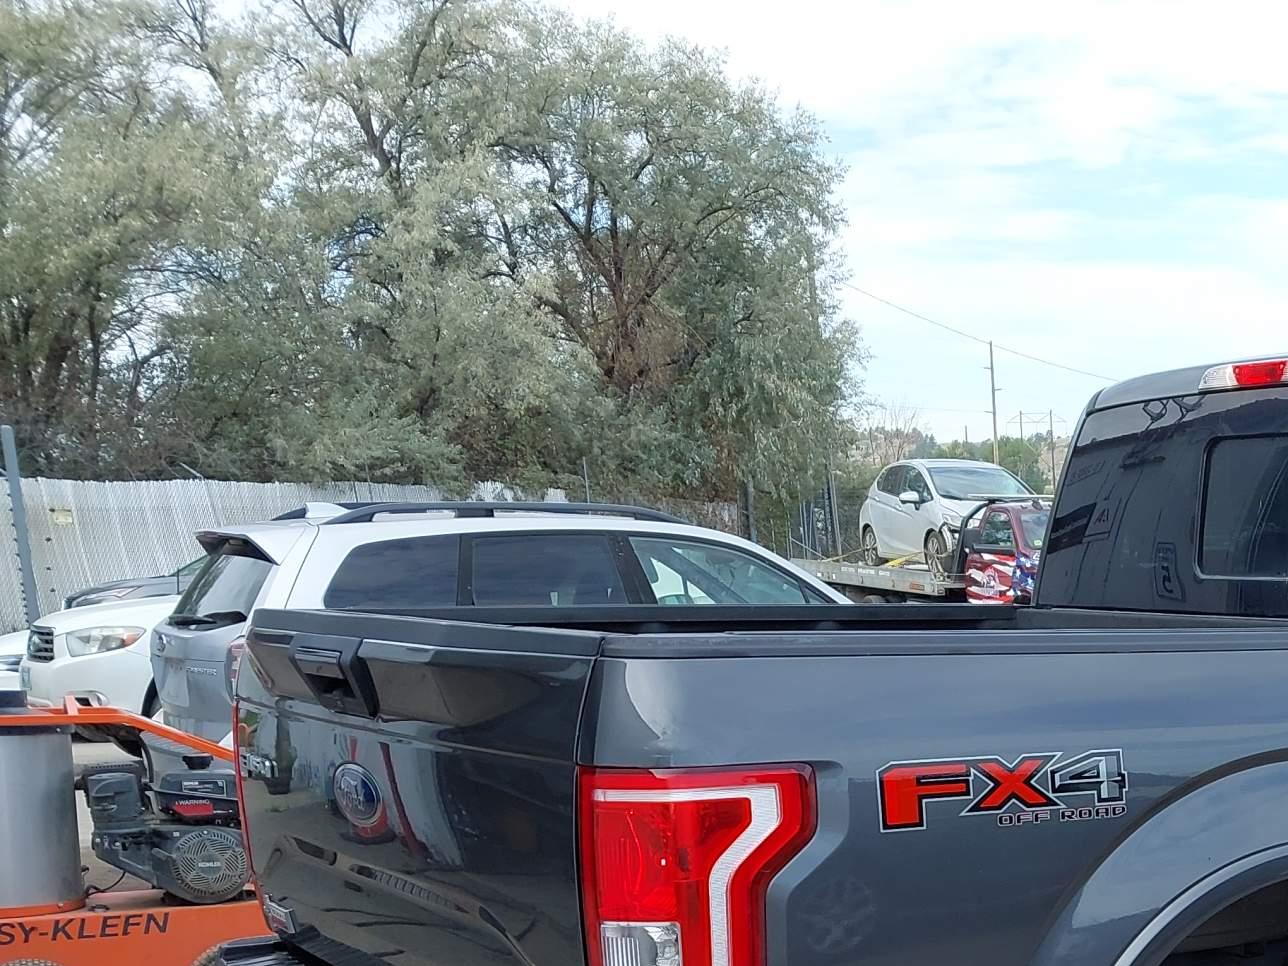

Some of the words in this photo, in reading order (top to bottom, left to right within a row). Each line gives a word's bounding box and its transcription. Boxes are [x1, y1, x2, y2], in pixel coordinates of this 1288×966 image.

[875, 748, 1129, 833] FX4
[998, 811, 1051, 827] OFF
[1060, 804, 1128, 822] ROAD
